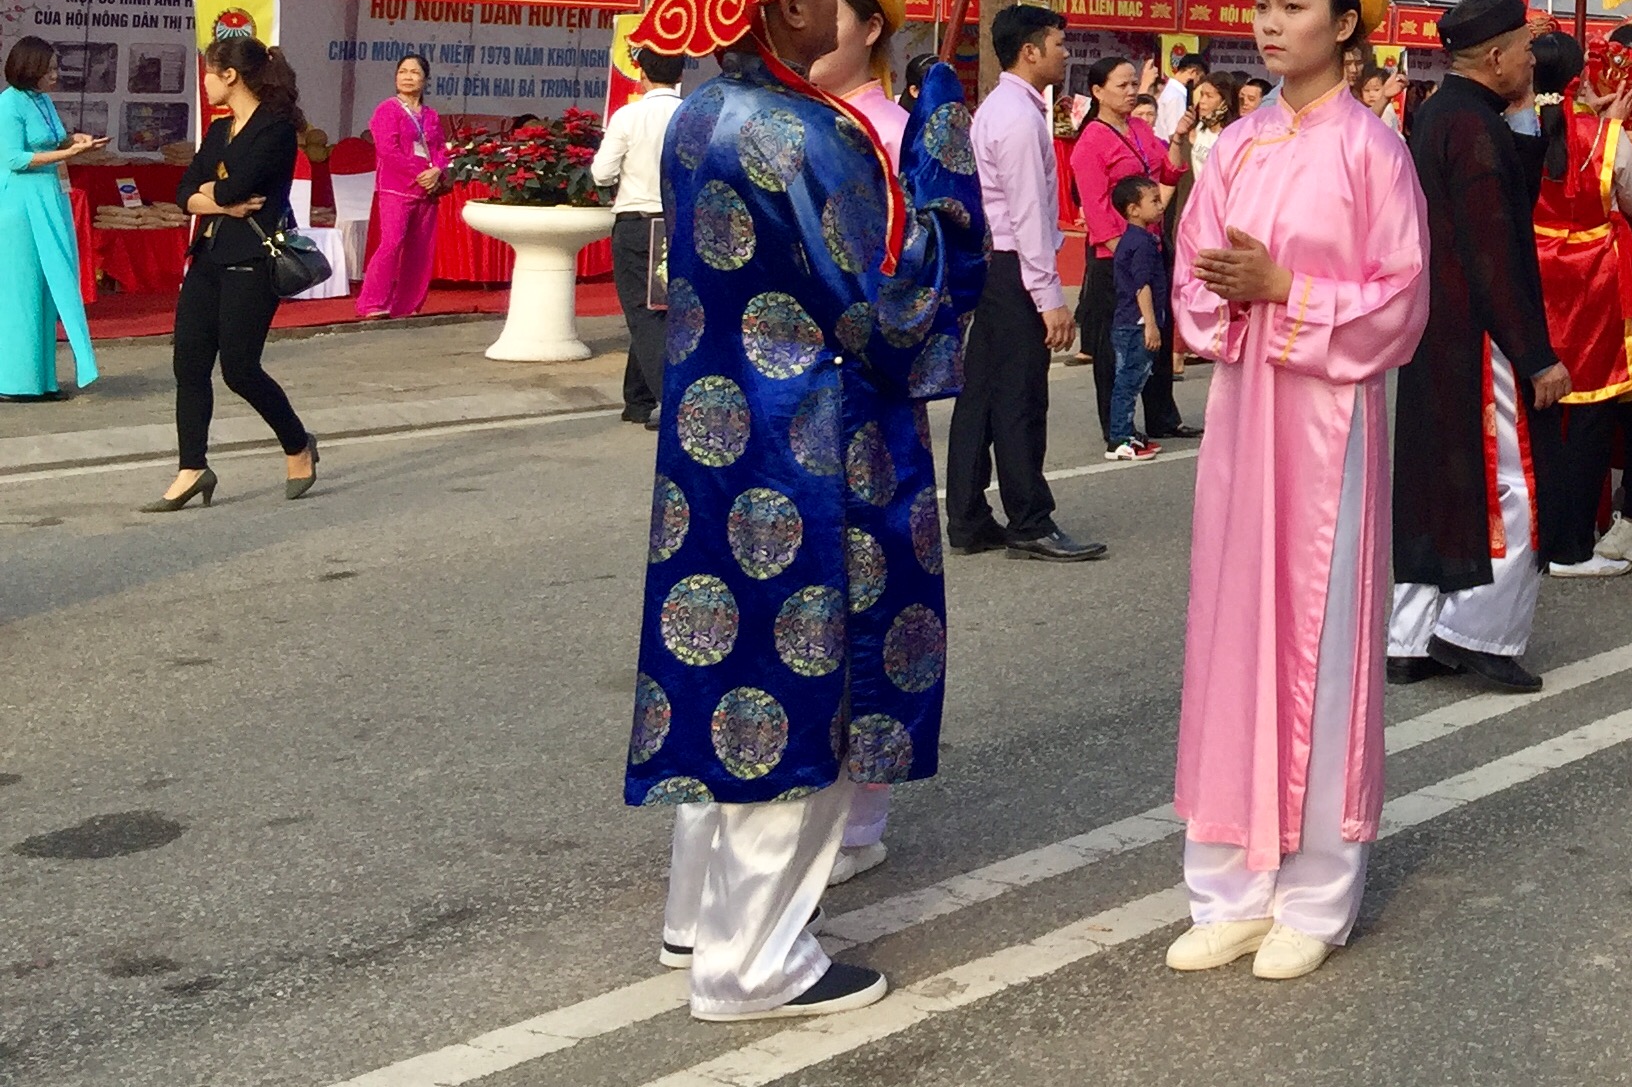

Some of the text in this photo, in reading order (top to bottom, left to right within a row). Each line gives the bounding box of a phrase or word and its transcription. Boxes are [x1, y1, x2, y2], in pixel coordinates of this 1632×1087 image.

[65, 8, 88, 31] HỘI
[92, 11, 128, 28] NÔNG
[132, 13, 159, 29] DÂN
[162, 15, 182, 32] THỊ
[440, 40, 475, 67] NIỆM
[480, 45, 511, 65] 1979
[514, 43, 544, 66] NĂM
[436, 73, 460, 100] HỘI
[493, 78, 515, 97] HAI
